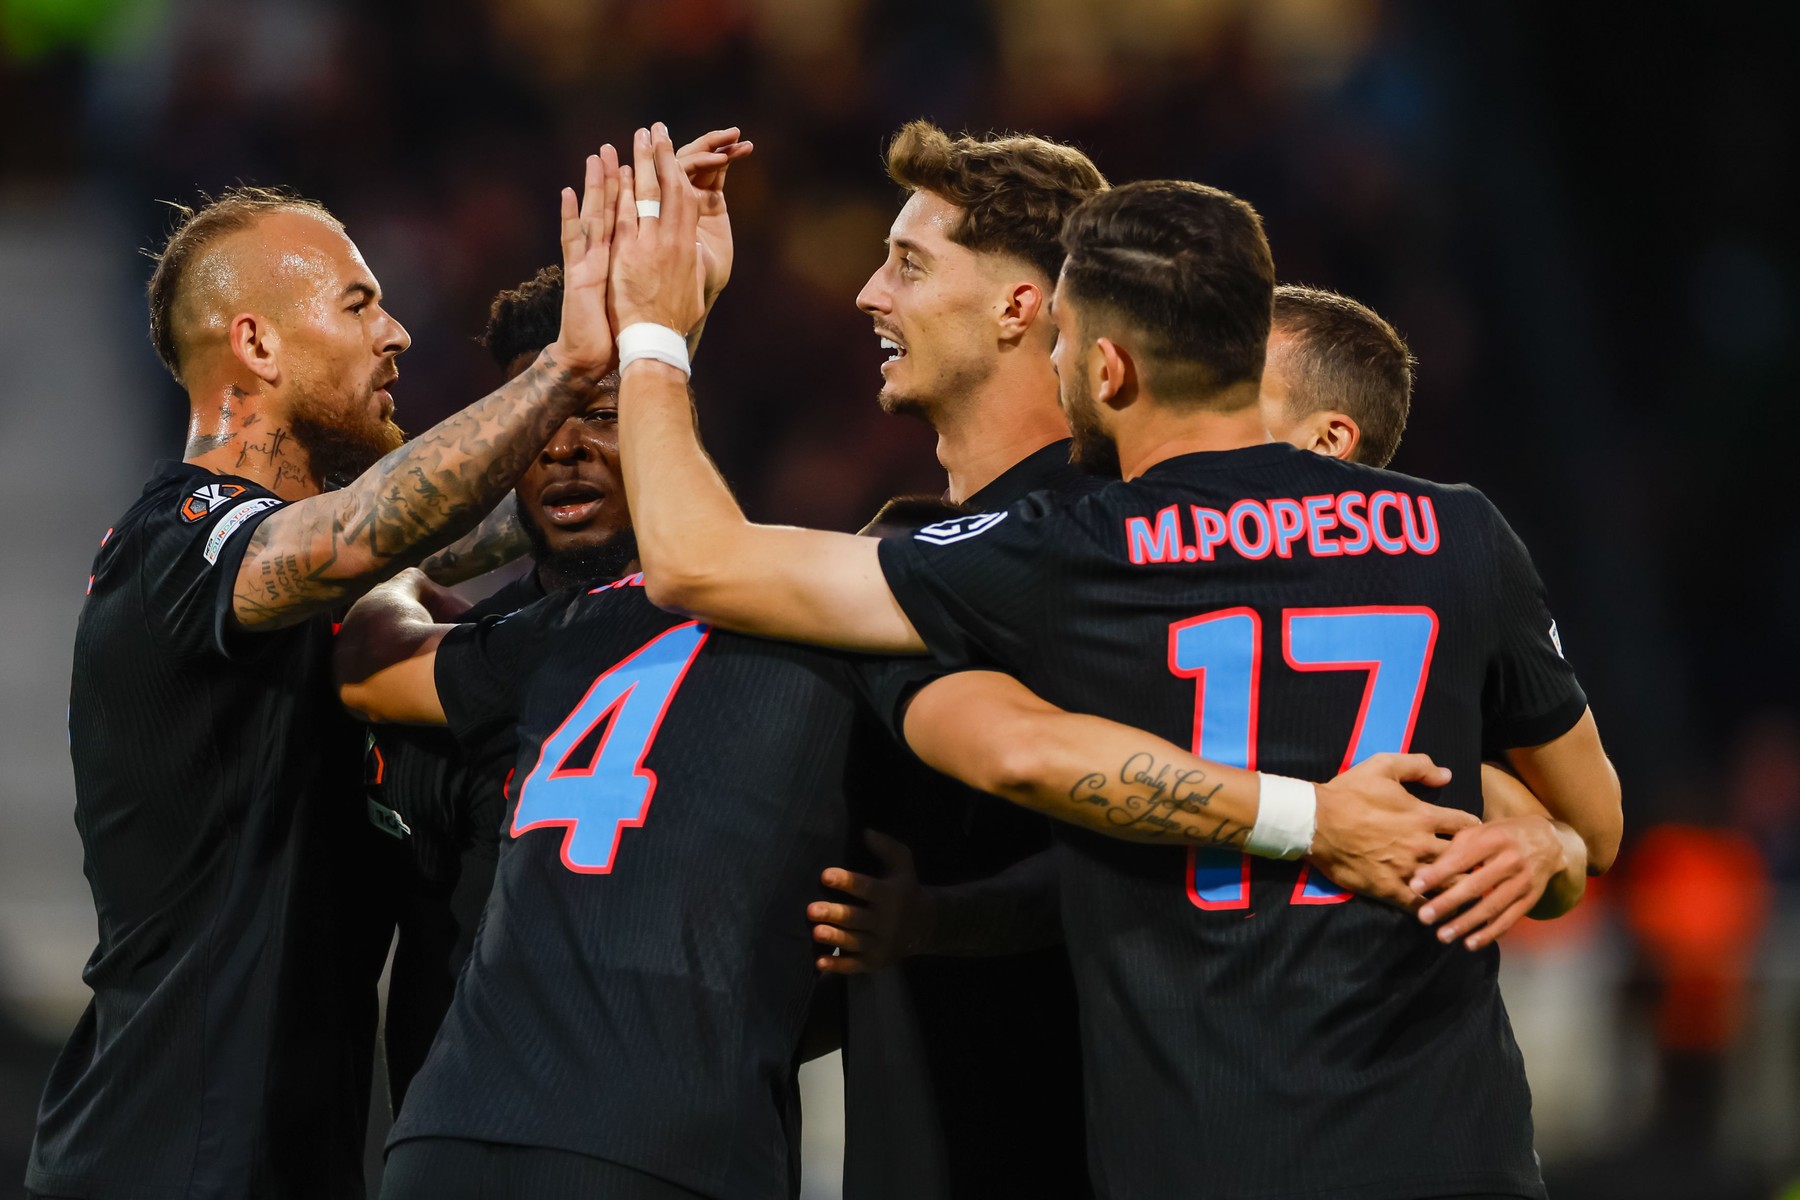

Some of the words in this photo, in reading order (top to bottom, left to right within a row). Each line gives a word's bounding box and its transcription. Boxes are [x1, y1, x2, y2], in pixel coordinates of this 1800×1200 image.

[236, 428, 294, 468] faith
[208, 505, 258, 561] FOUNDATION
[1125, 490, 1440, 565] M.POPESCU
[510, 619, 712, 875] 4
[1168, 605, 1439, 911] 17
